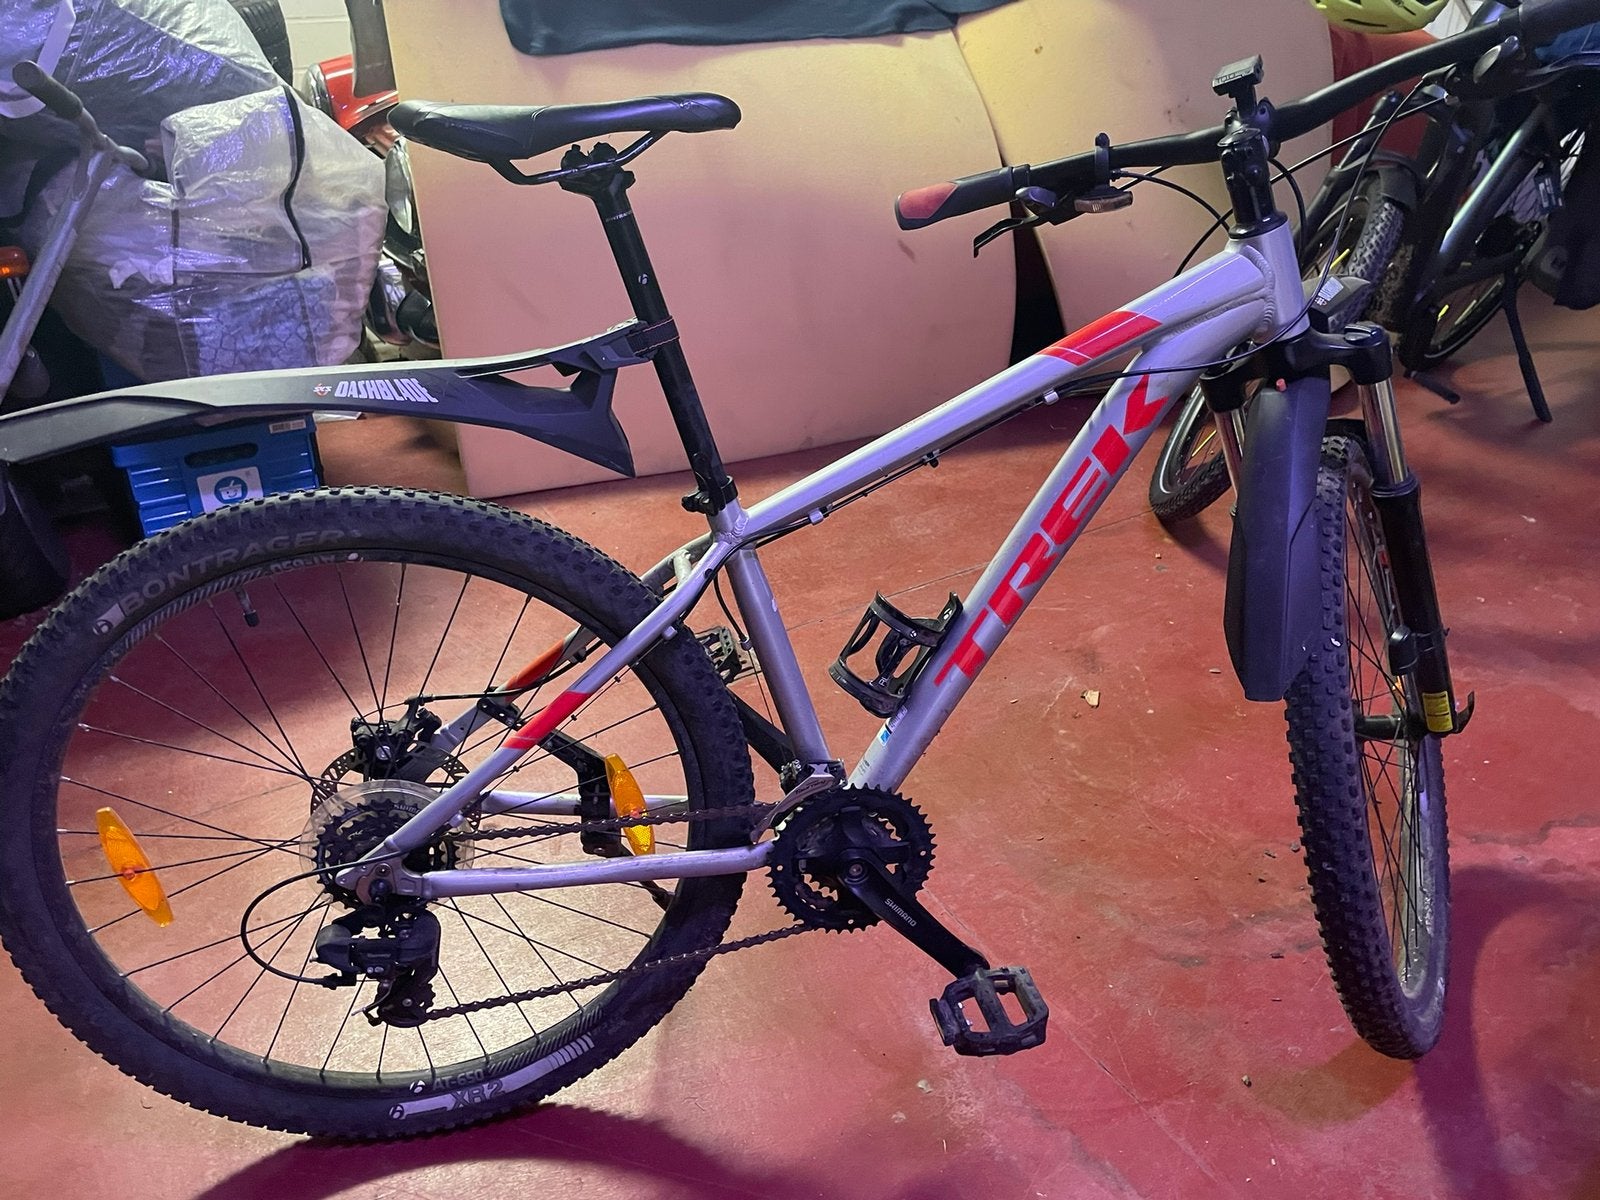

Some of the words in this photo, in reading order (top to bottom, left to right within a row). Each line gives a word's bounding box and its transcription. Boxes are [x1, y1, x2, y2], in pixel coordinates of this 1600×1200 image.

[334, 378, 439, 403] DASHBLADE
[934, 374, 1169, 686] TREK
[122, 529, 346, 613] BONTRAGER
[884, 898, 917, 927] SHIMANO
[432, 1068, 485, 1091] AT-650
